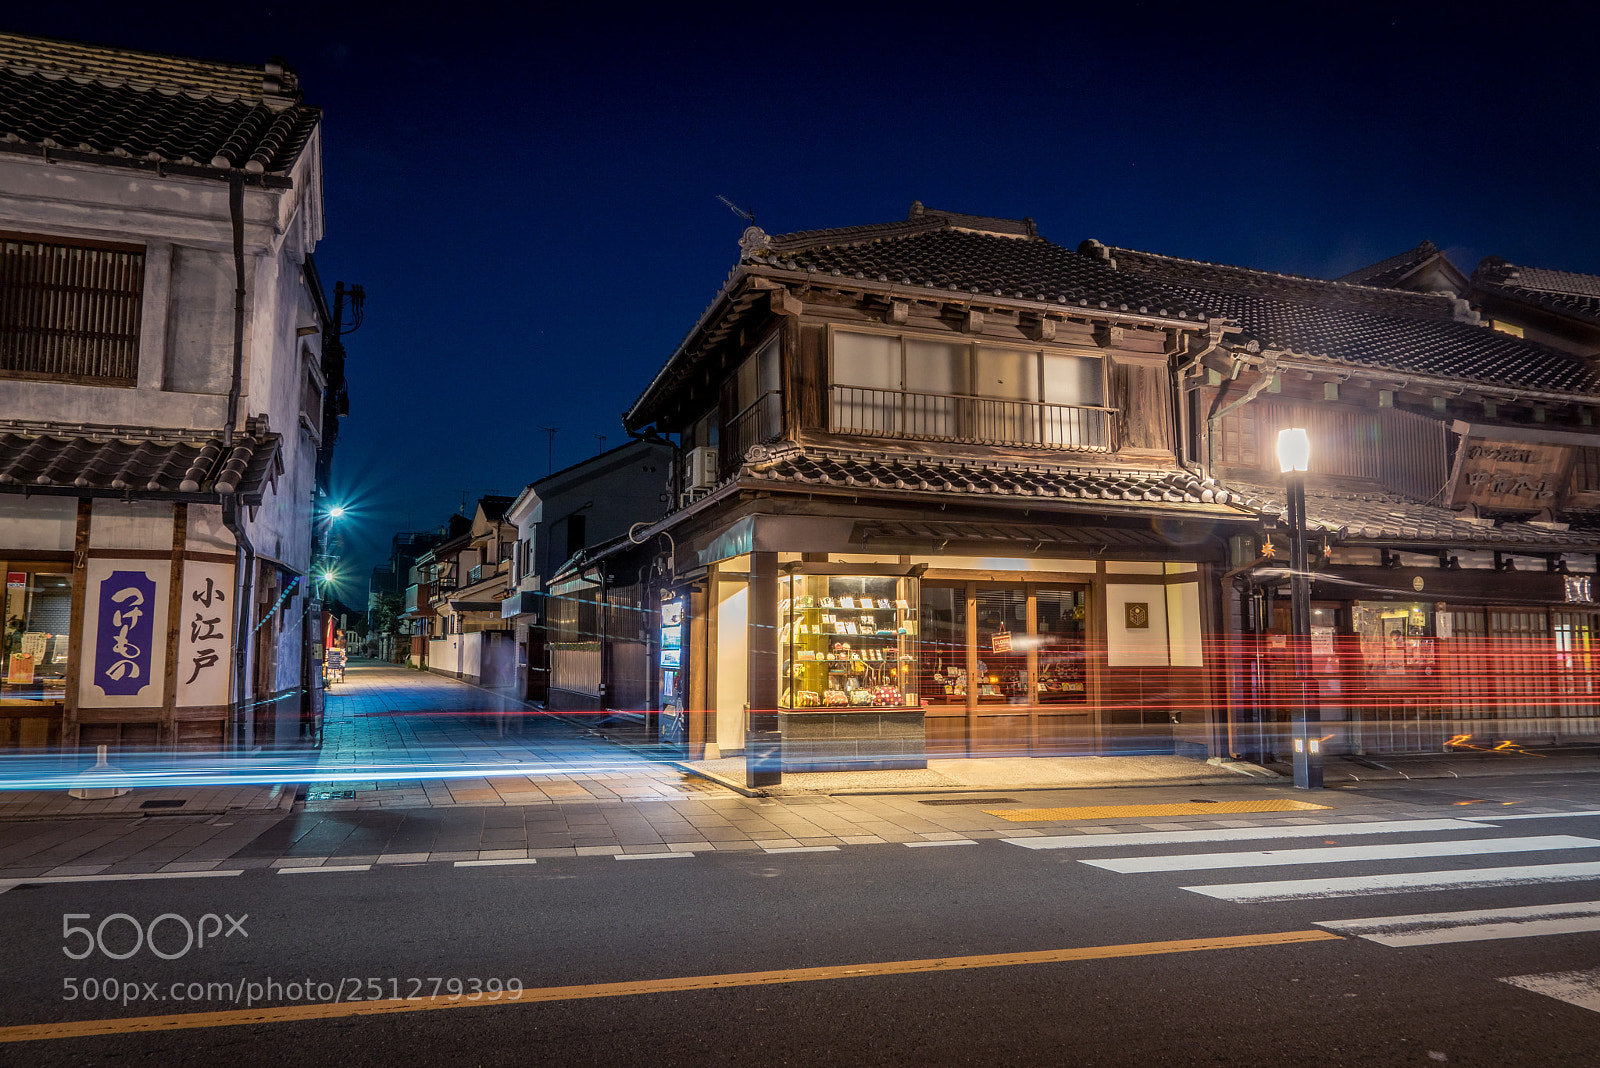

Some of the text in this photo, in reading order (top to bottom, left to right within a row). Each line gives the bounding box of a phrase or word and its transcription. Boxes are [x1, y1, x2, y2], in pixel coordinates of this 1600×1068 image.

[105, 587, 145, 681] つけもの
[186, 577, 226, 685] 小江戸
